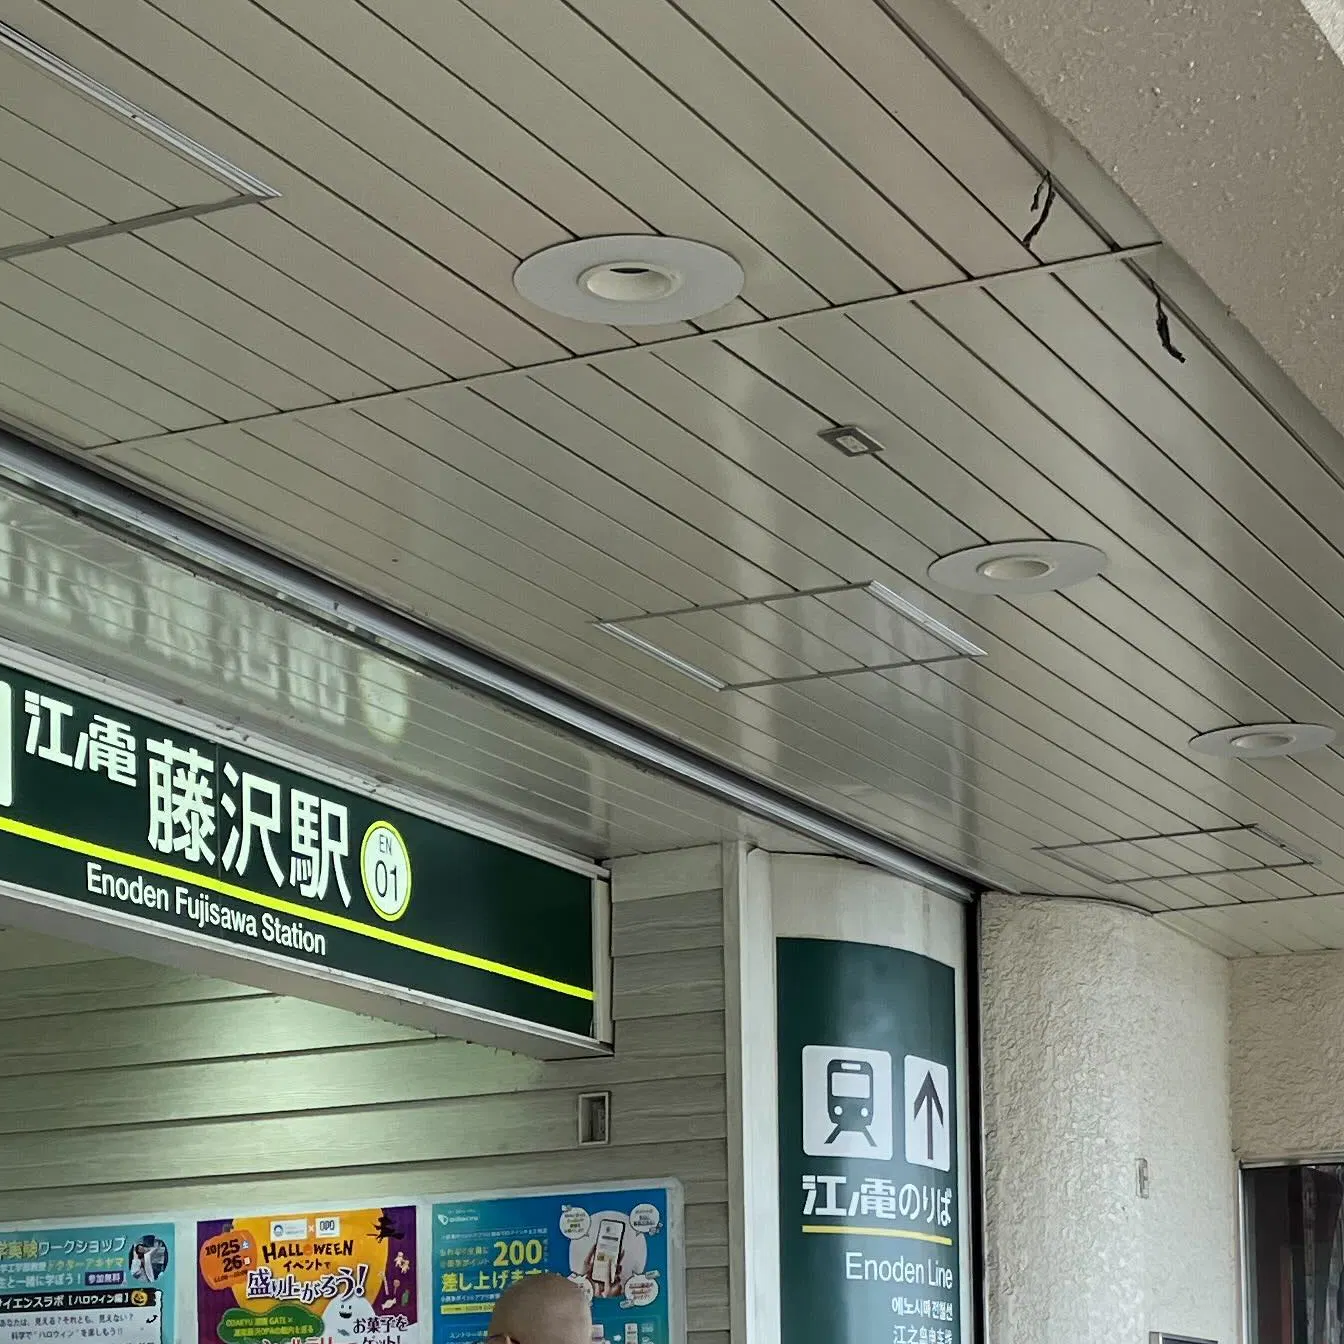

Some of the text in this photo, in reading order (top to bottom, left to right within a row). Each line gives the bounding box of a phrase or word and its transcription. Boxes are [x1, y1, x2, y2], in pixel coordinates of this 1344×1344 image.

[146, 737, 354, 908] 藤沢駅
[379, 833, 393, 856] EN
[375, 860, 398, 902] 01
[86, 861, 326, 956] Enoden Fujisawa Station
[493, 1239, 542, 1267] 200
[846, 1252, 953, 1290] Enoden Line
[353, 1316, 408, 1334] お菓子を
